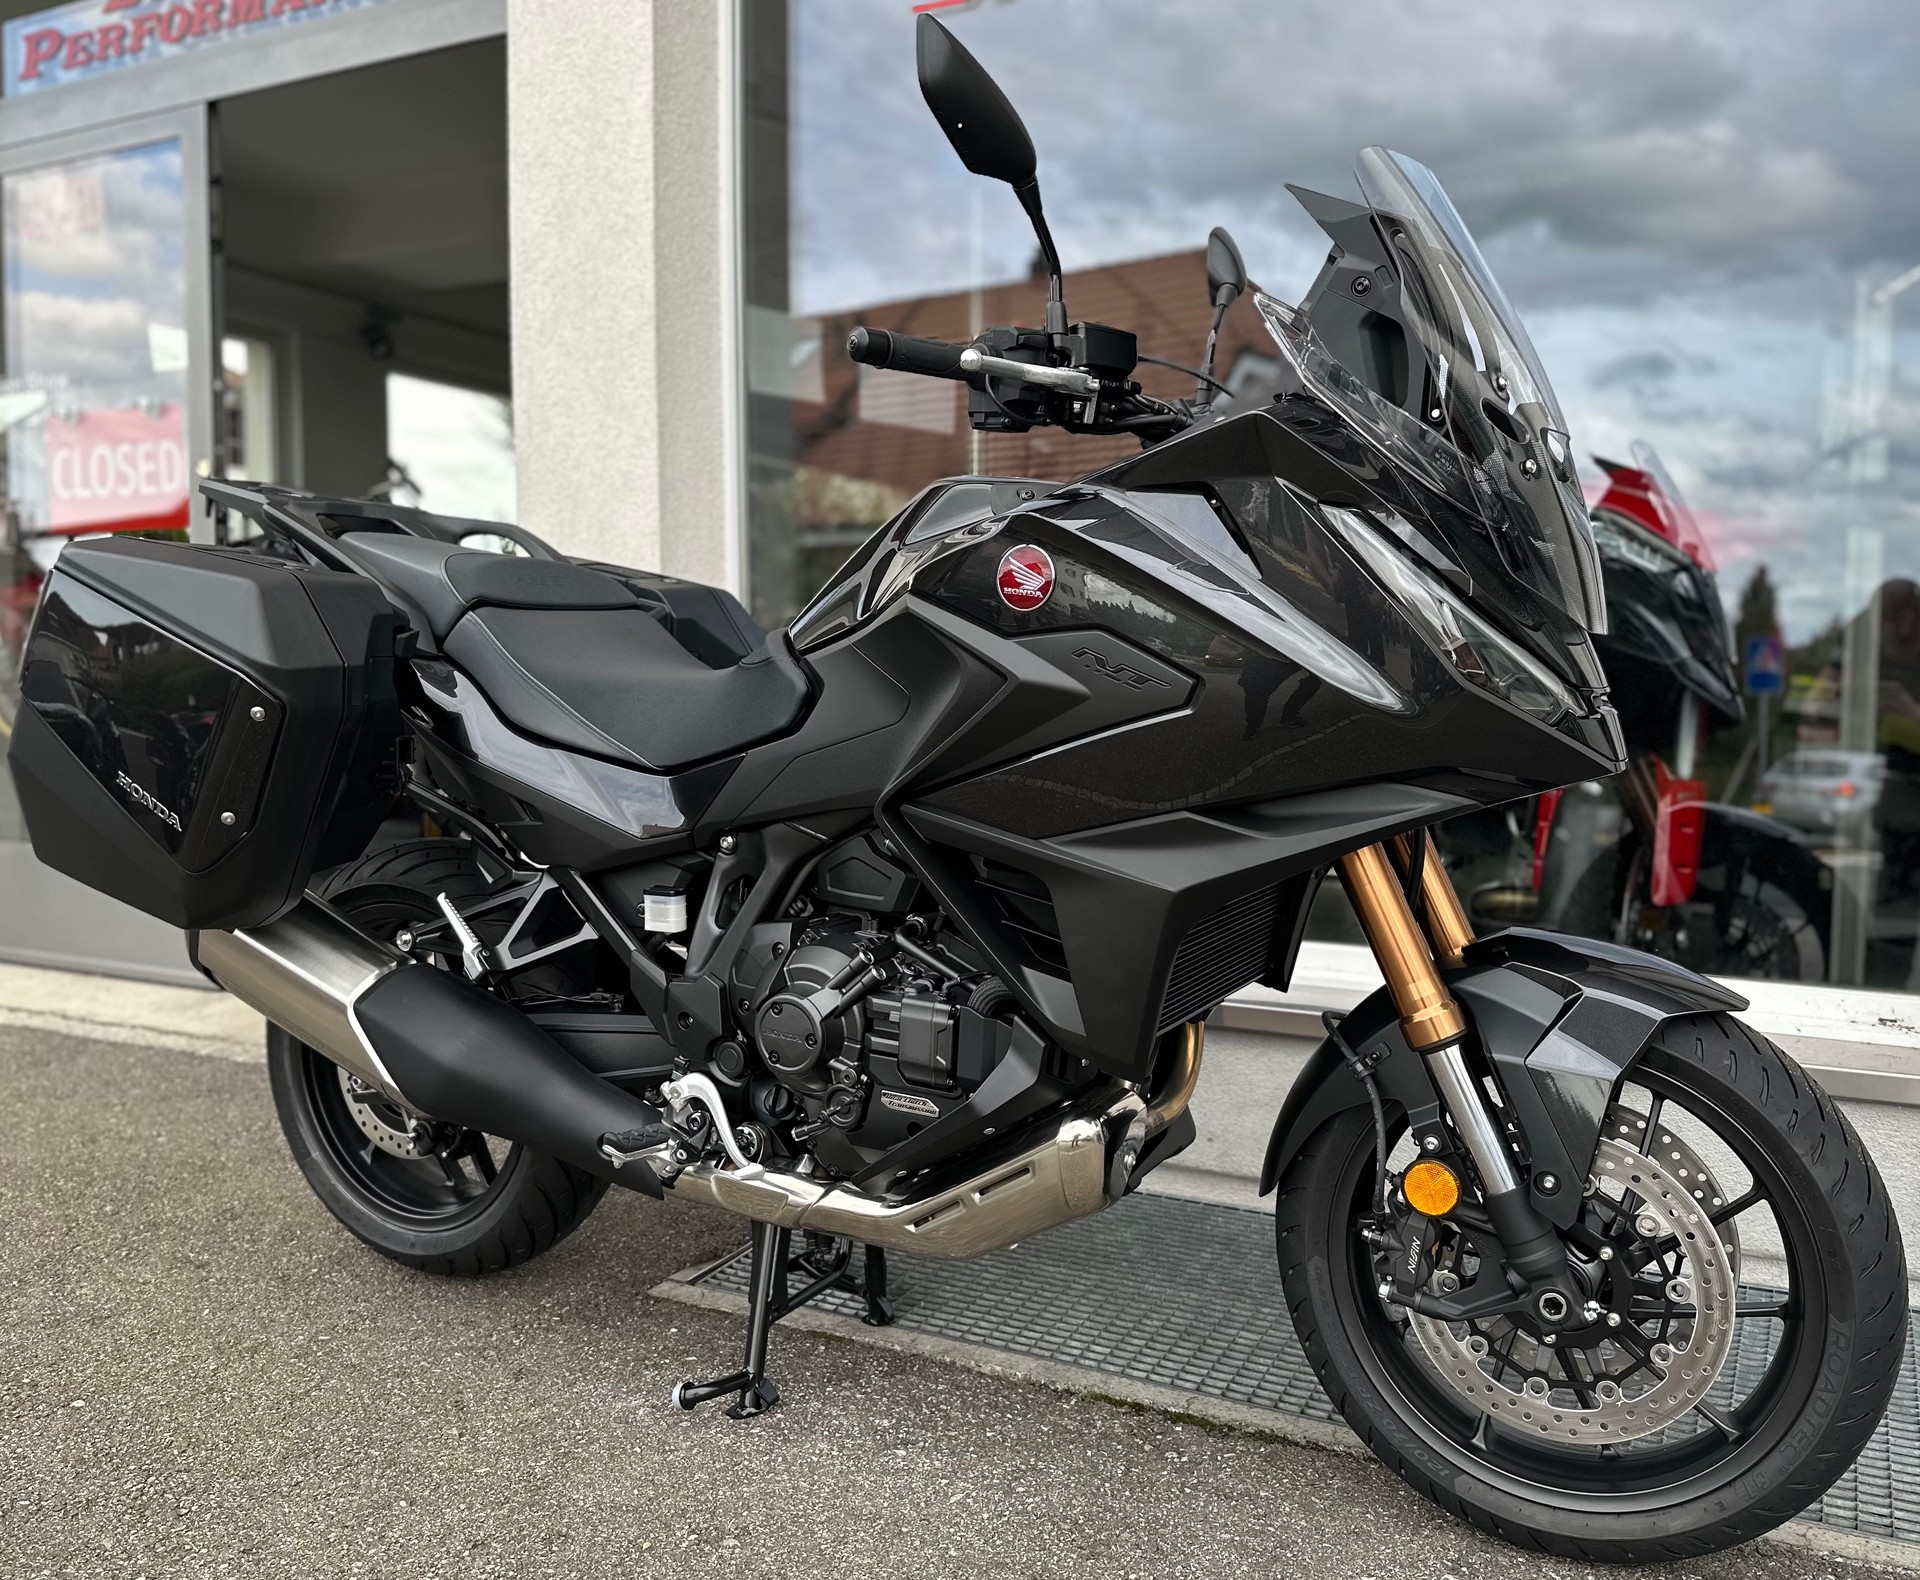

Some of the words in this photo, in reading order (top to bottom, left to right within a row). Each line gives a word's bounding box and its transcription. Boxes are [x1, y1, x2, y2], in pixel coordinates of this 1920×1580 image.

[53, 439, 183, 499] CLOSED
[1003, 587, 1044, 598] HONDA
[116, 770, 182, 832] HONDA
[763, 1028, 802, 1043] HONDA
[1407, 1235, 1421, 1275] NISSIN
[1779, 1325, 1850, 1466] ROADTEC
